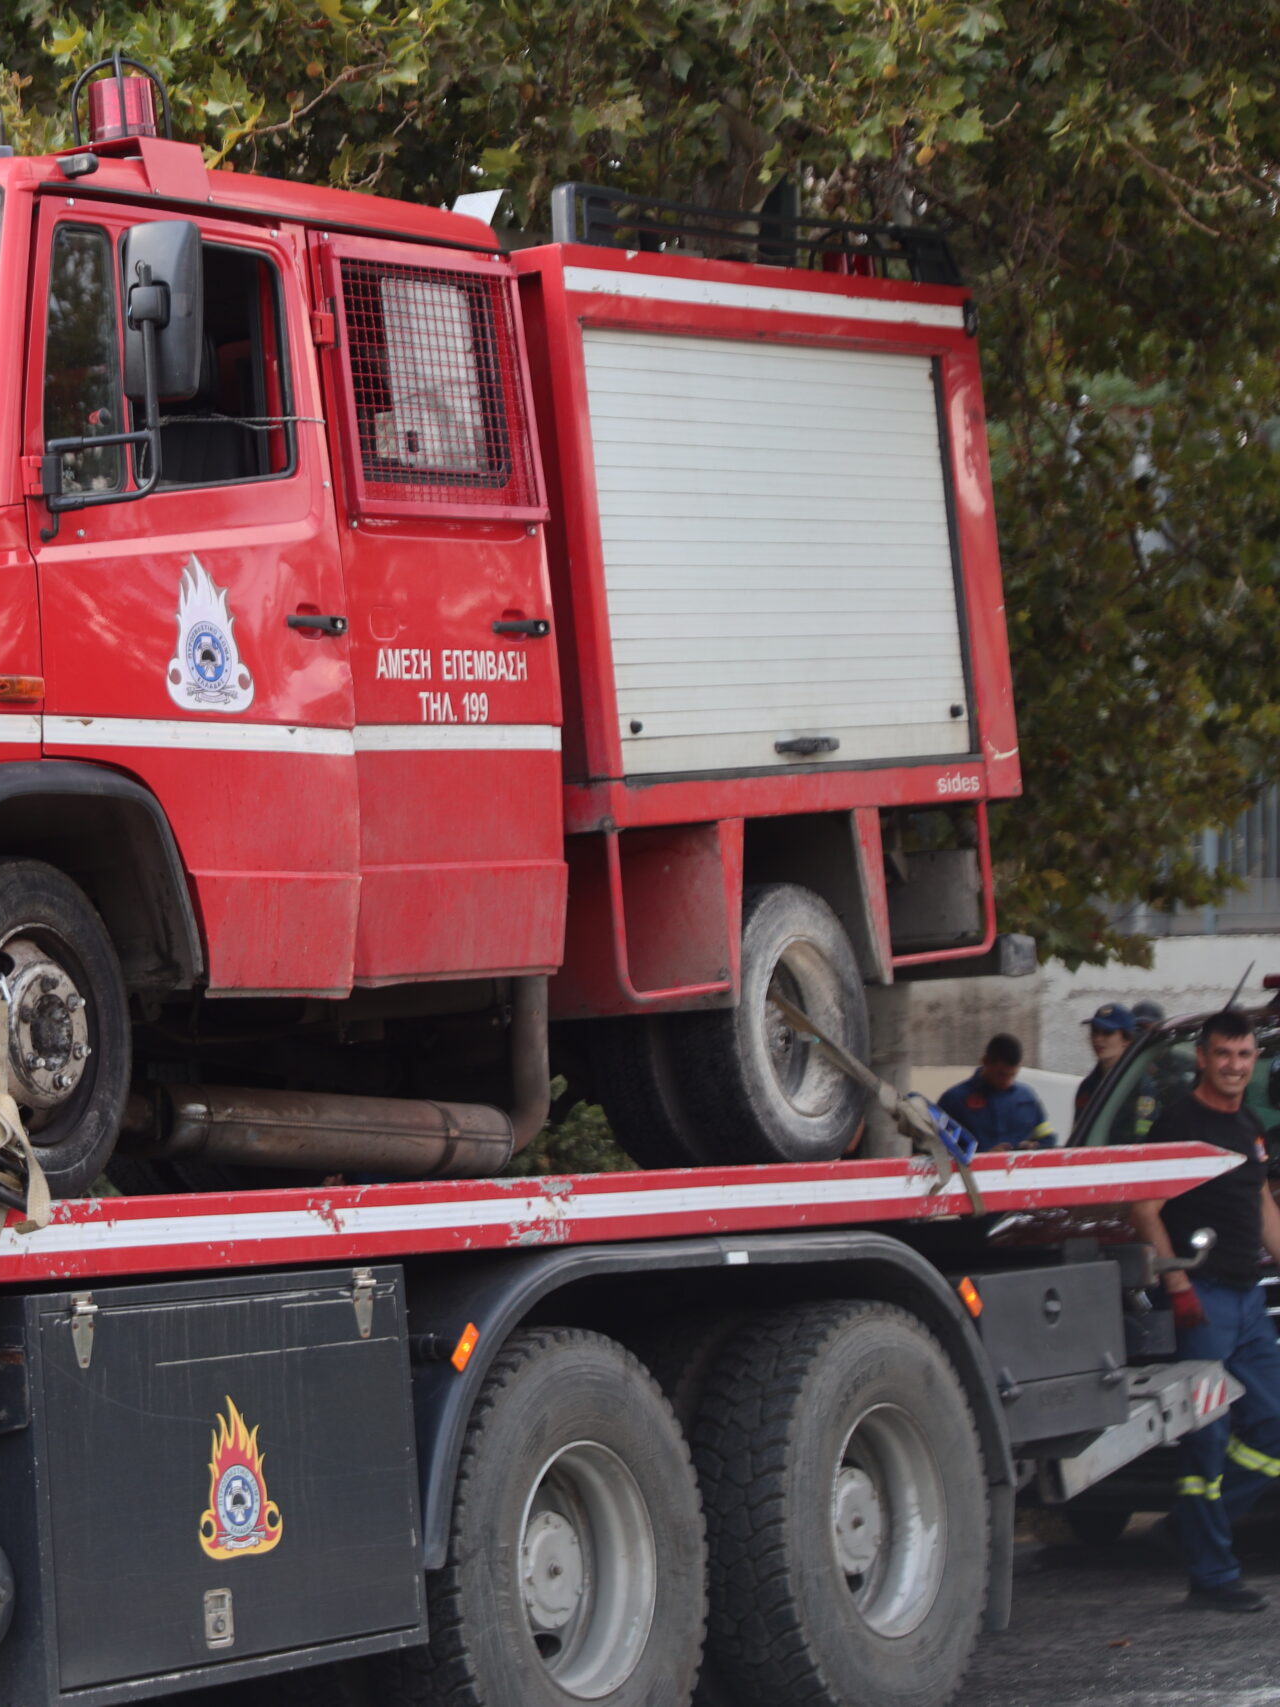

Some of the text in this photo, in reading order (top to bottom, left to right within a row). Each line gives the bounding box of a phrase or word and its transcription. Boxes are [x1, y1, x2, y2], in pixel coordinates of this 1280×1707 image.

[376, 649, 528, 681] ΑΜΕΣΗ ΕΠΕΜΒΑΣΗ
[419, 691, 489, 722] ΤΗΛ. 199
[936, 771, 980, 794] sides
